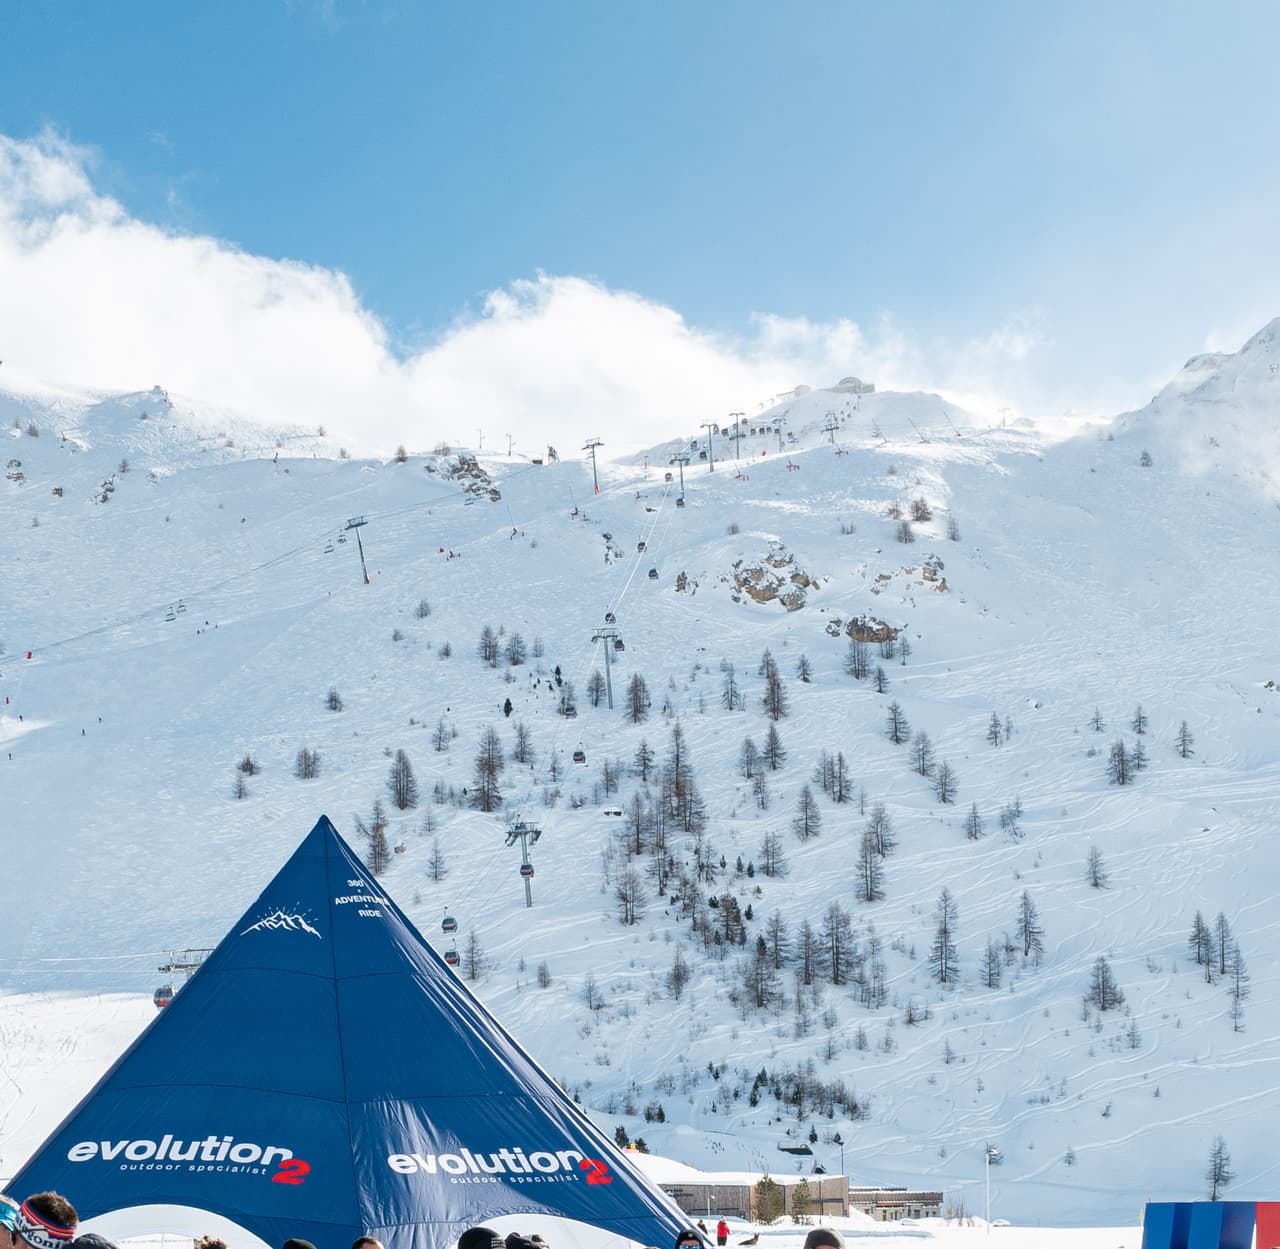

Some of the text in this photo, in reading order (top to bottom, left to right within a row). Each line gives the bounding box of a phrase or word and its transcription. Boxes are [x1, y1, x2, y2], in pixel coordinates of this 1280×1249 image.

[358, 909, 383, 918] RIDE
[67, 1134, 312, 1185] evolution 2
[387, 1147, 614, 1185] evolution 2
[120, 1163, 267, 1176] outdoor specialist
[450, 1173, 580, 1185] outdoor specialist
